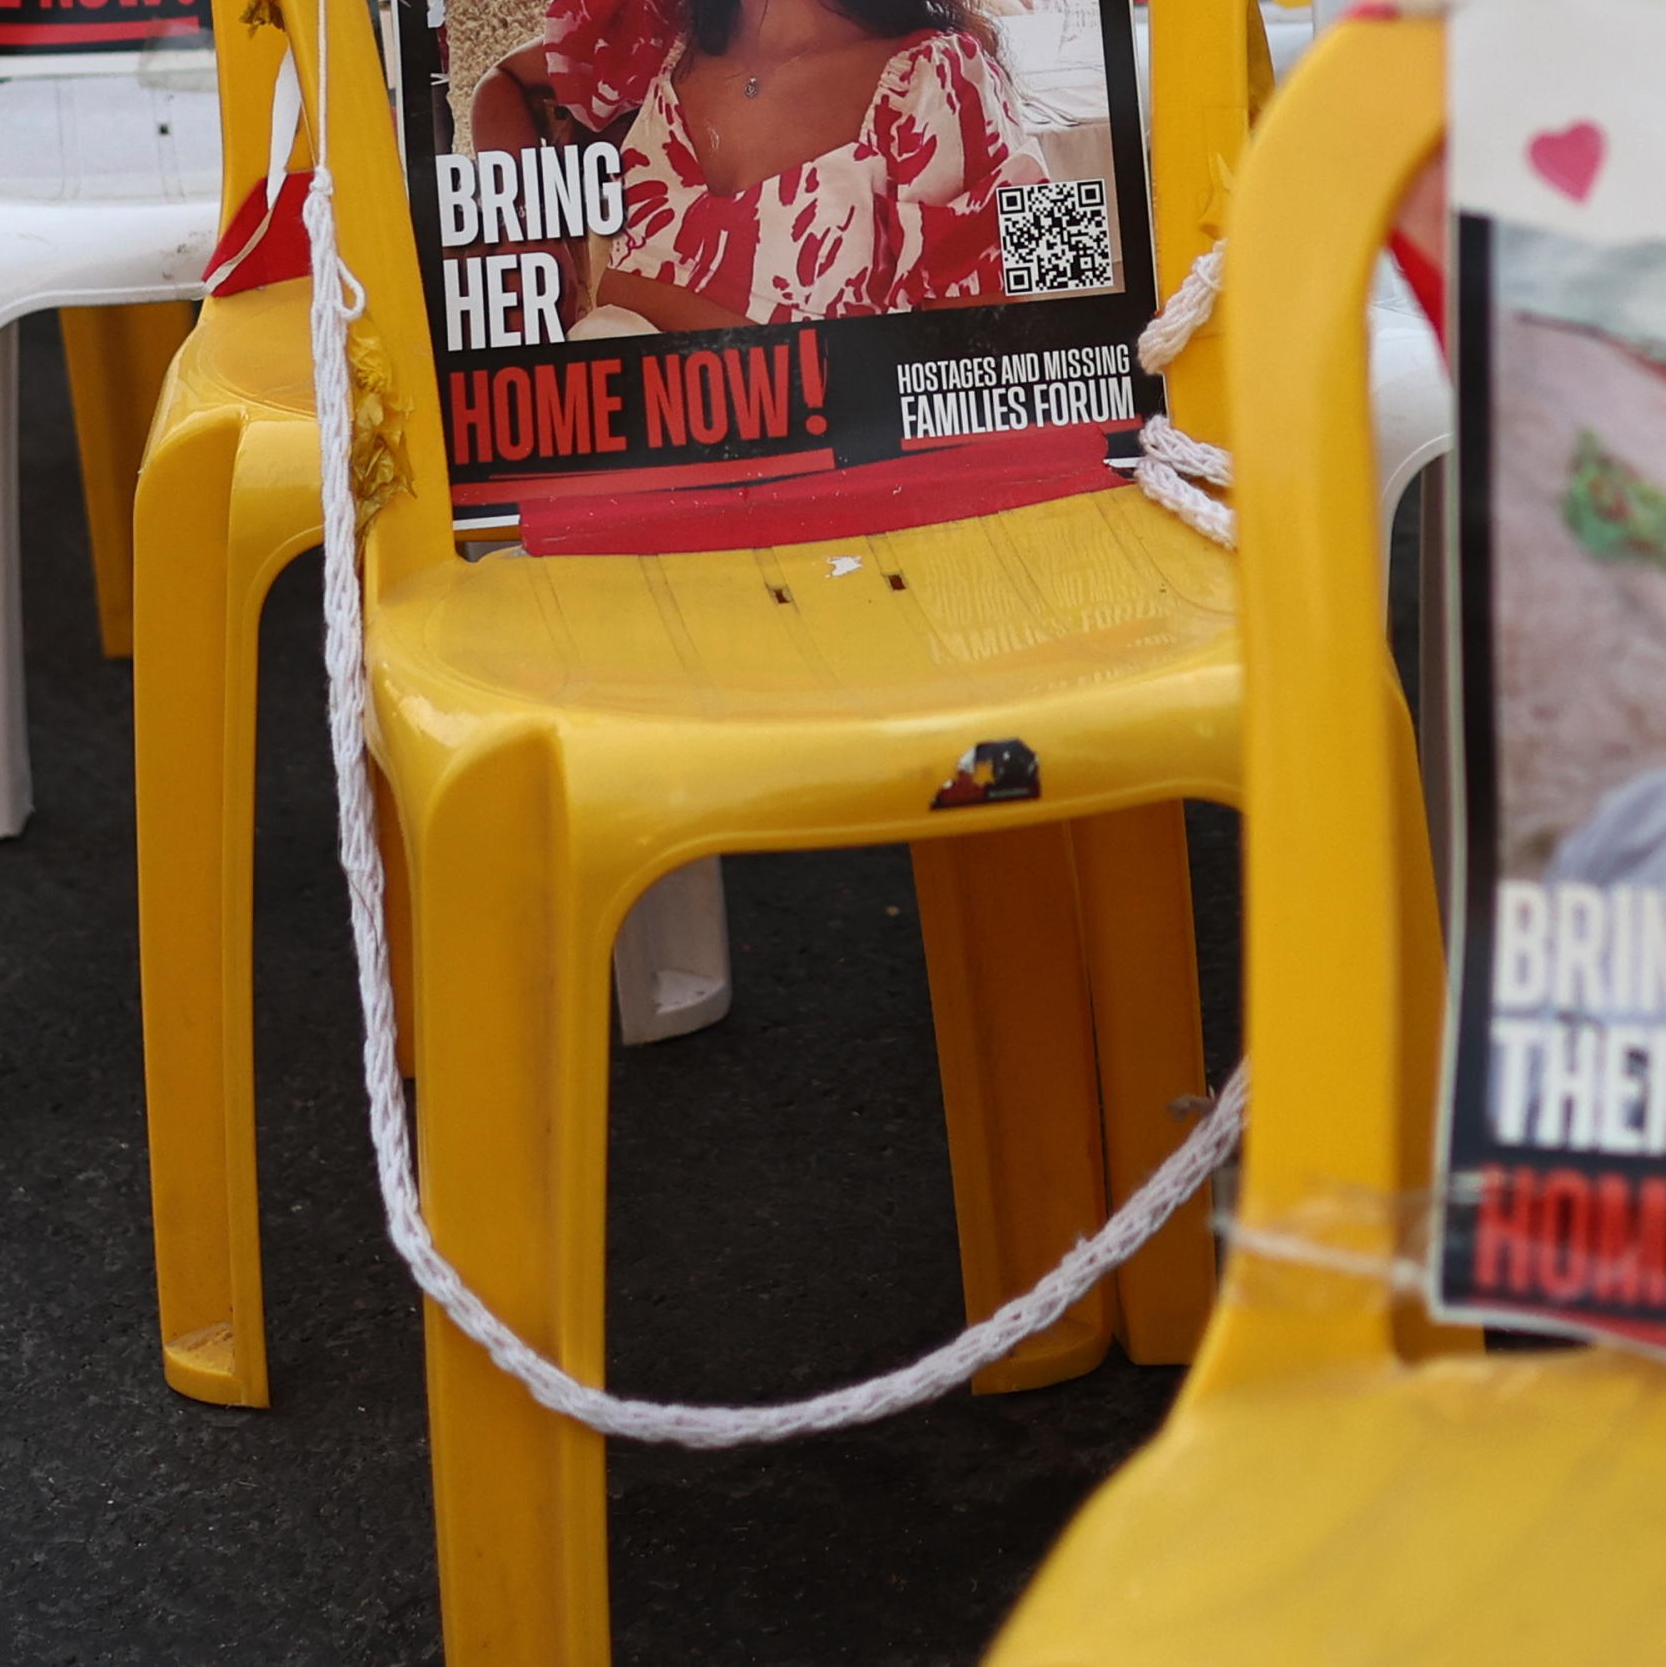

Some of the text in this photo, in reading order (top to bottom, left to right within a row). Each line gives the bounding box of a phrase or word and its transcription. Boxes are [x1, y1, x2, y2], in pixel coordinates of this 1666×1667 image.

[435, 140, 624, 246] BRING
[442, 252, 565, 351] HER
[449, 328, 830, 467] HOME NOW!
[897, 343, 1131, 395] HOSTAGES AND MISSING
[900, 376, 1136, 440] FAMILIES FORUM
